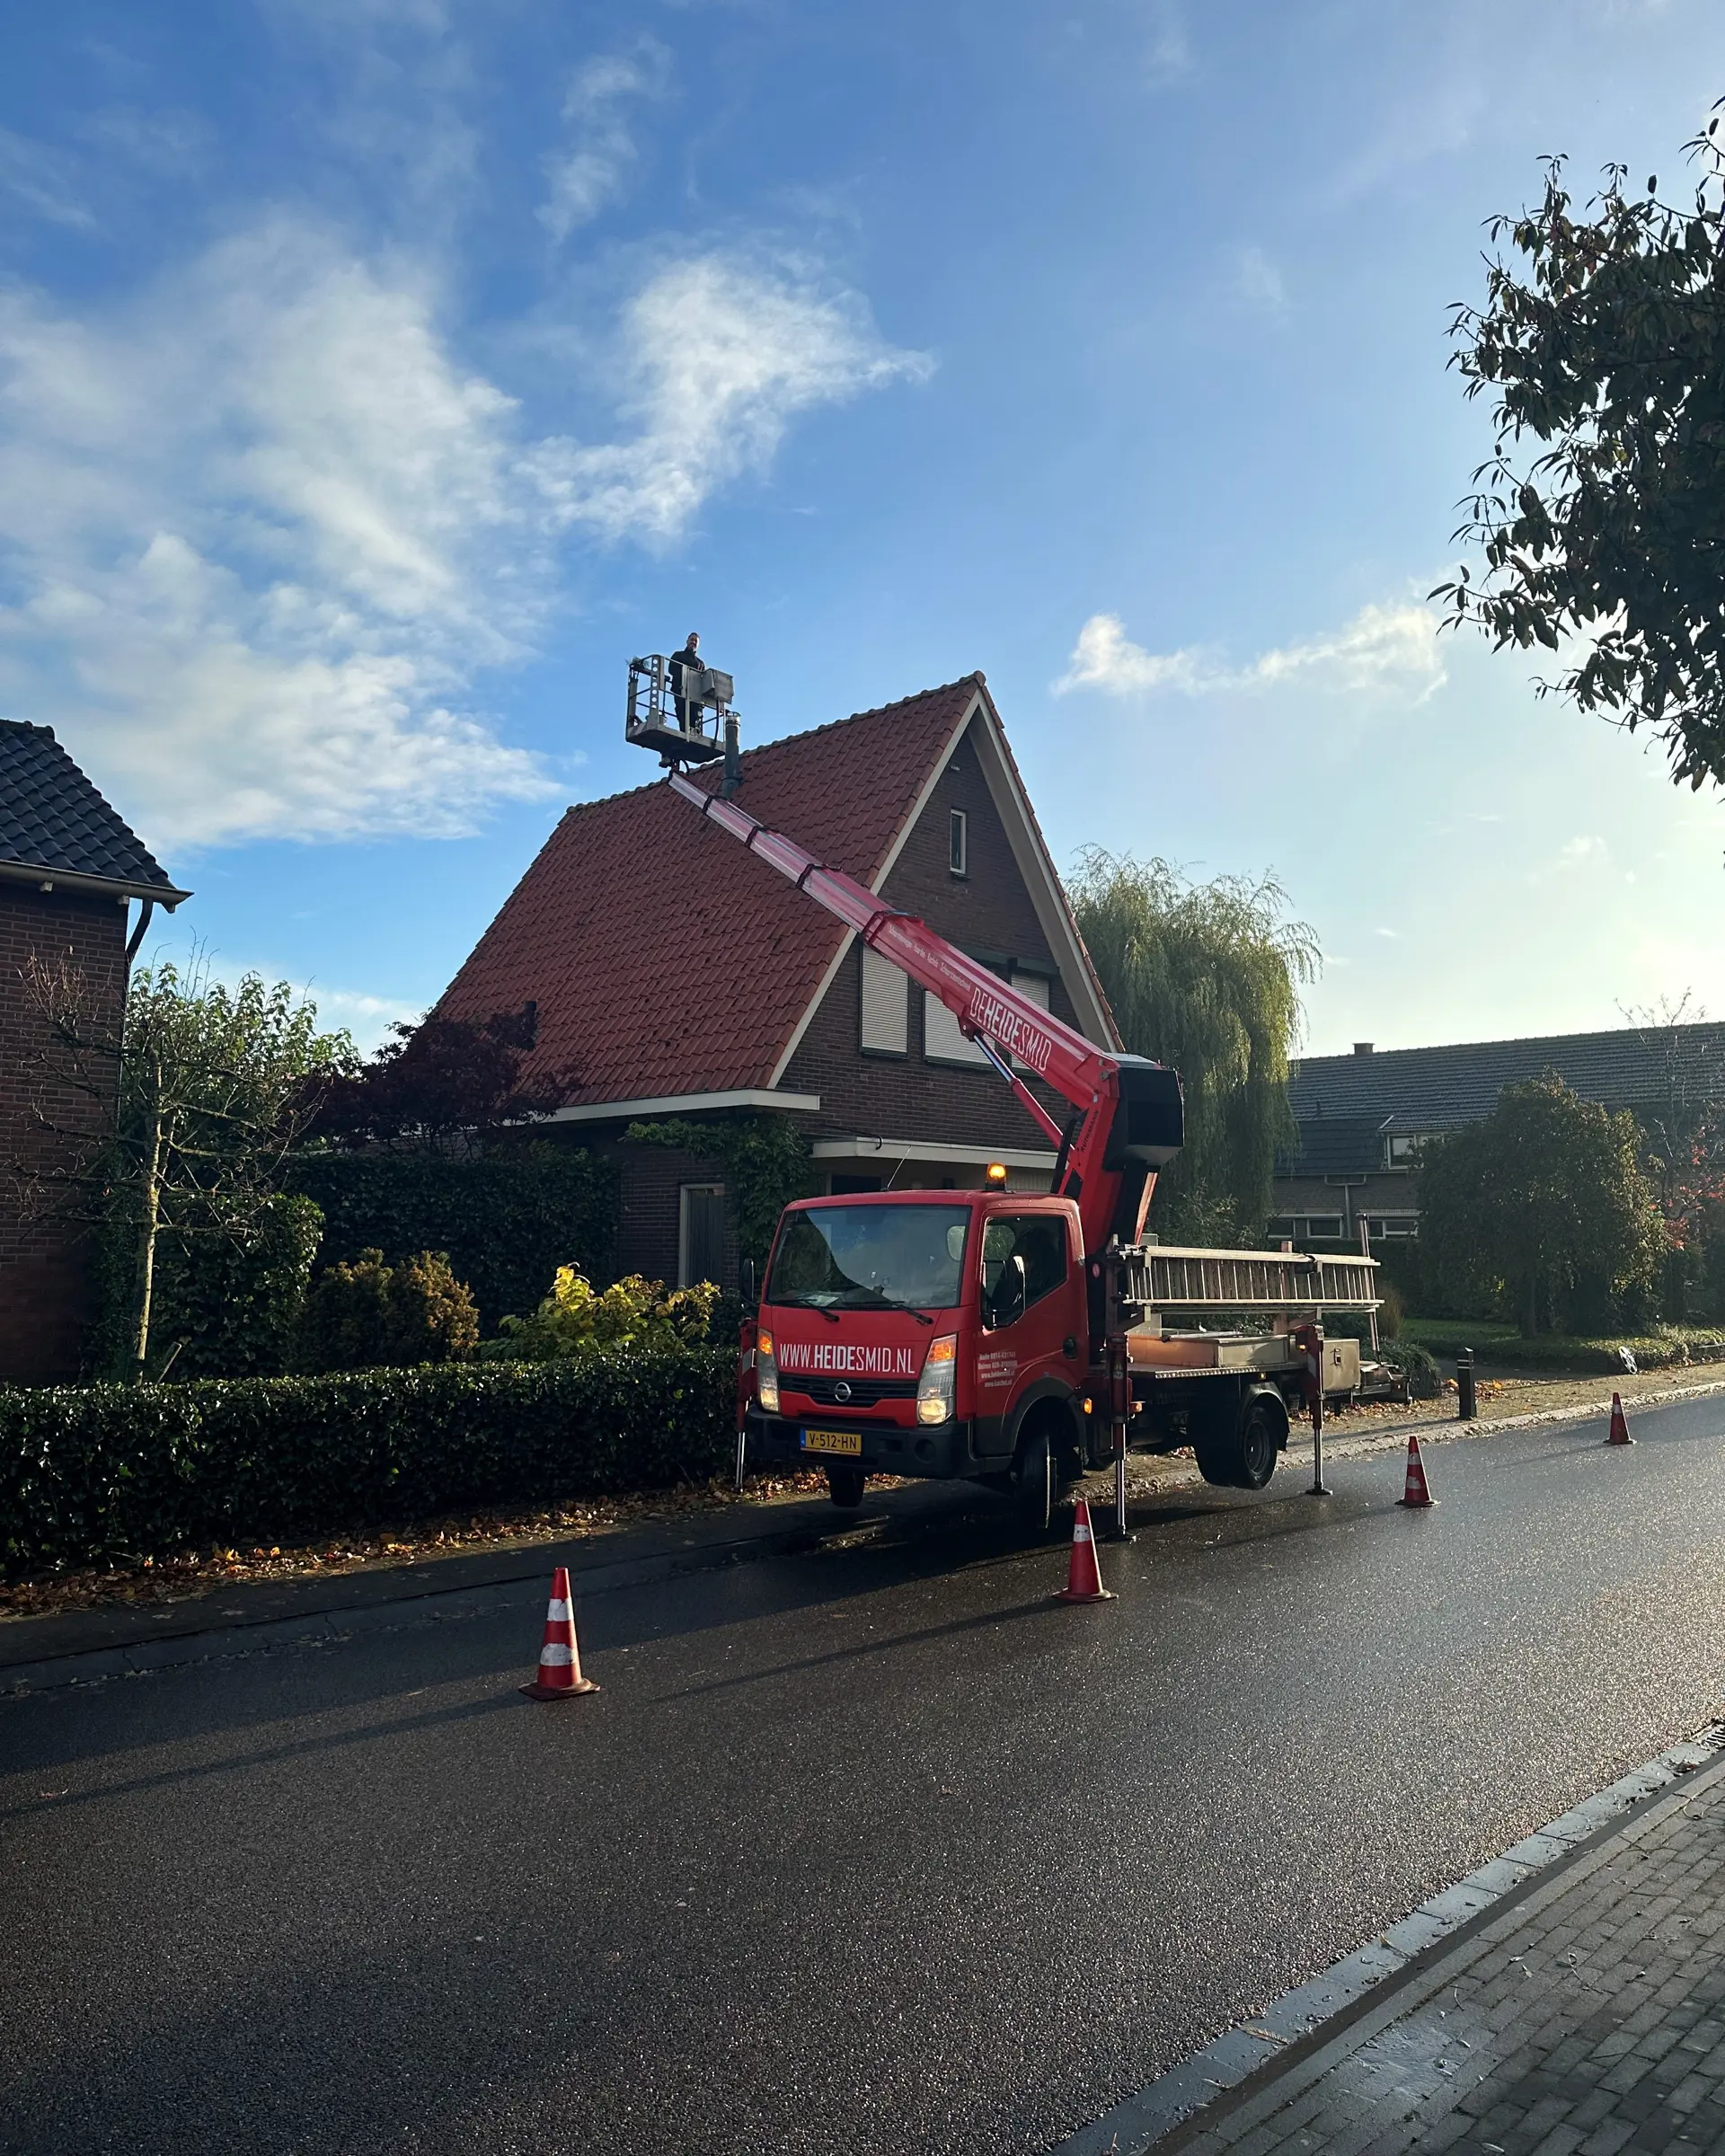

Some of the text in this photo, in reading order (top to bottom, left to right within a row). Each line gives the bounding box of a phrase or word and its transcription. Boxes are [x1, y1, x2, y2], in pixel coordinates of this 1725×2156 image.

[970, 987, 1052, 1071] DEHEIDESMID
[780, 1343, 916, 1374] WWW.HEIDESMID.NL
[809, 1433, 856, 1450] V-512-HN
